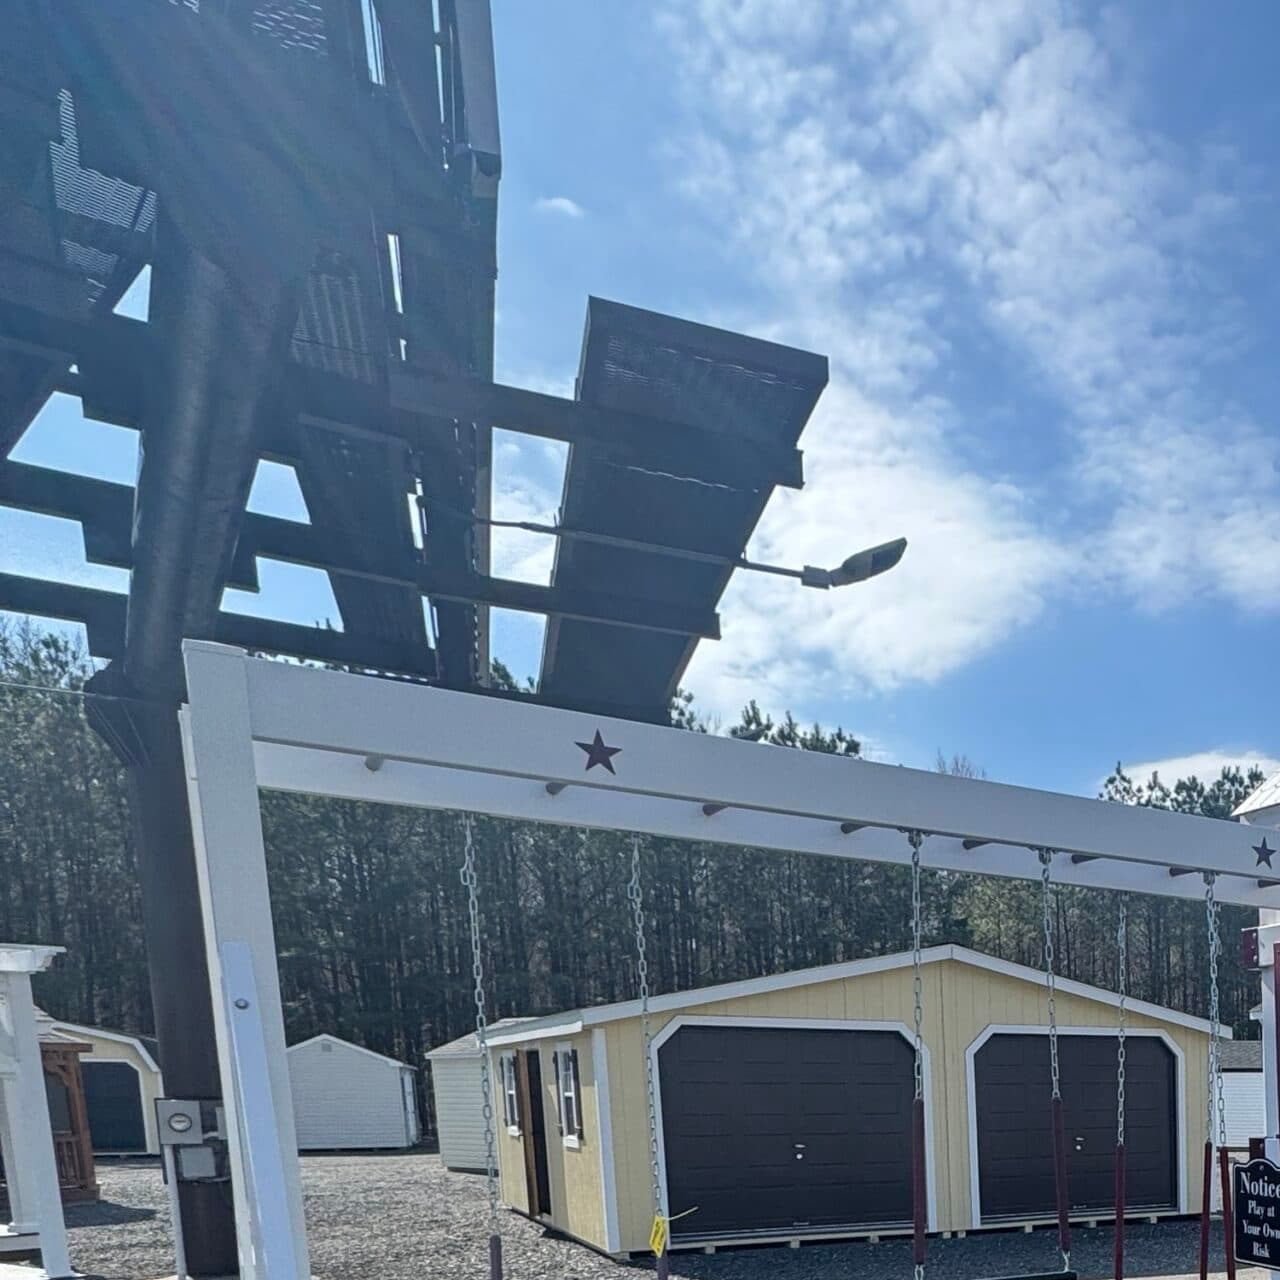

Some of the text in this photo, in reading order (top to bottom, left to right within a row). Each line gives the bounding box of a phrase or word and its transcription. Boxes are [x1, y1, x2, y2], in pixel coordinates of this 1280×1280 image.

[1248, 1200, 1275, 1219] Play at
[1242, 1219, 1280, 1240] Your Own
[1252, 1241, 1270, 1258] Risk
